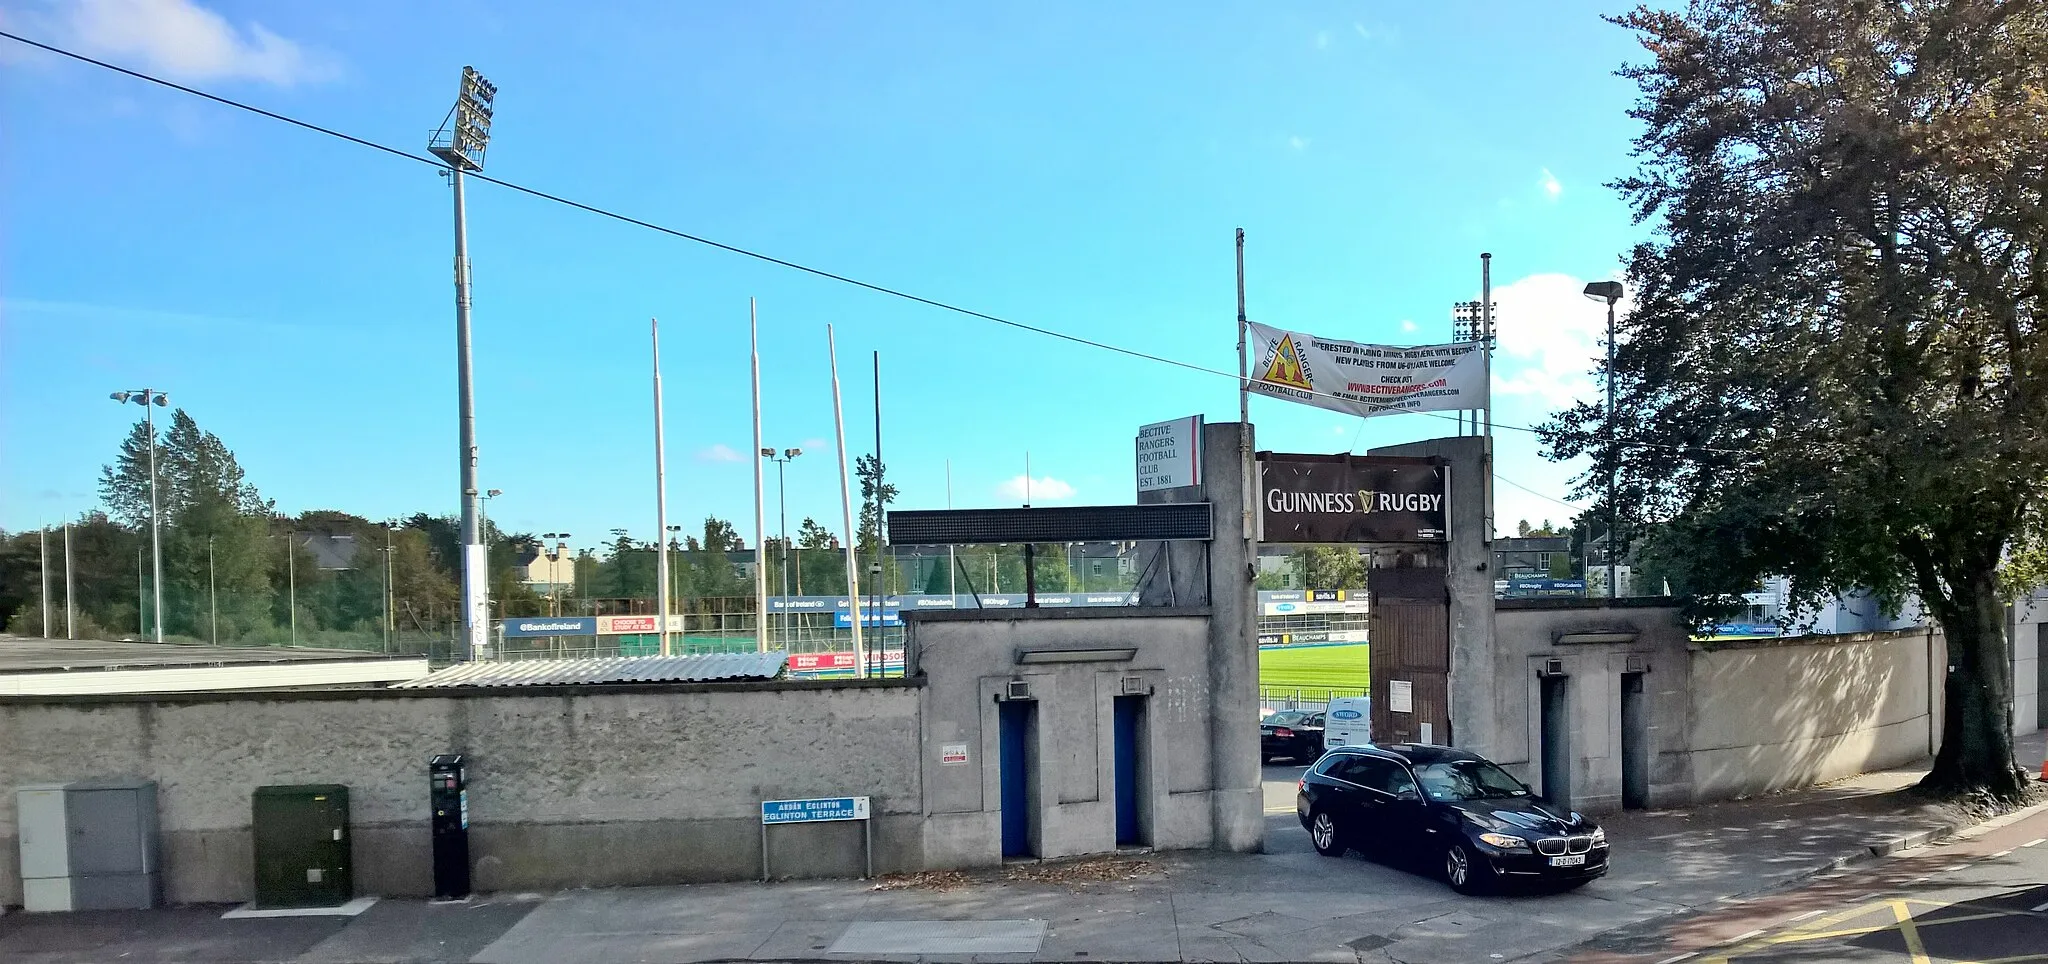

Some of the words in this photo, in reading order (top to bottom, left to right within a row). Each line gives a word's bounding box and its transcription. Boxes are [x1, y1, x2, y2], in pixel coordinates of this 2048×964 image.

[1294, 341, 1314, 383] RANGERS
[1335, 355, 1352, 365] NEW
[1376, 360, 1396, 369] FROM
[1416, 360, 1428, 368] ARE
[1428, 358, 1456, 368] WELCOME
[1380, 375, 1401, 384] CHECK
[1258, 383, 1294, 397] FOOTBALL
[1296, 390, 1313, 400] CLUB
[1407, 400, 1421, 408] INFO
[1140, 425, 1171, 438] BECTIVE
[1140, 436, 1175, 451] RANGERS
[1140, 449, 1177, 463] FOOTBALL
[1140, 464, 1158, 475] CLUB
[1140, 477, 1155, 487] EST.
[1157, 474, 1172, 485] 1881
[1267, 488, 1354, 513] GUINNESS
[1379, 494, 1441, 512] RUGBY
[1316, 592, 1335, 600] savills.ie
[520, 623, 581, 631] @BankofIreland
[1292, 634, 1326, 642] BEAUCHAMPS
[858, 804, 863, 812] 4
[764, 812, 807, 820] EGLINTON
[812, 809, 854, 818] TERRACE
